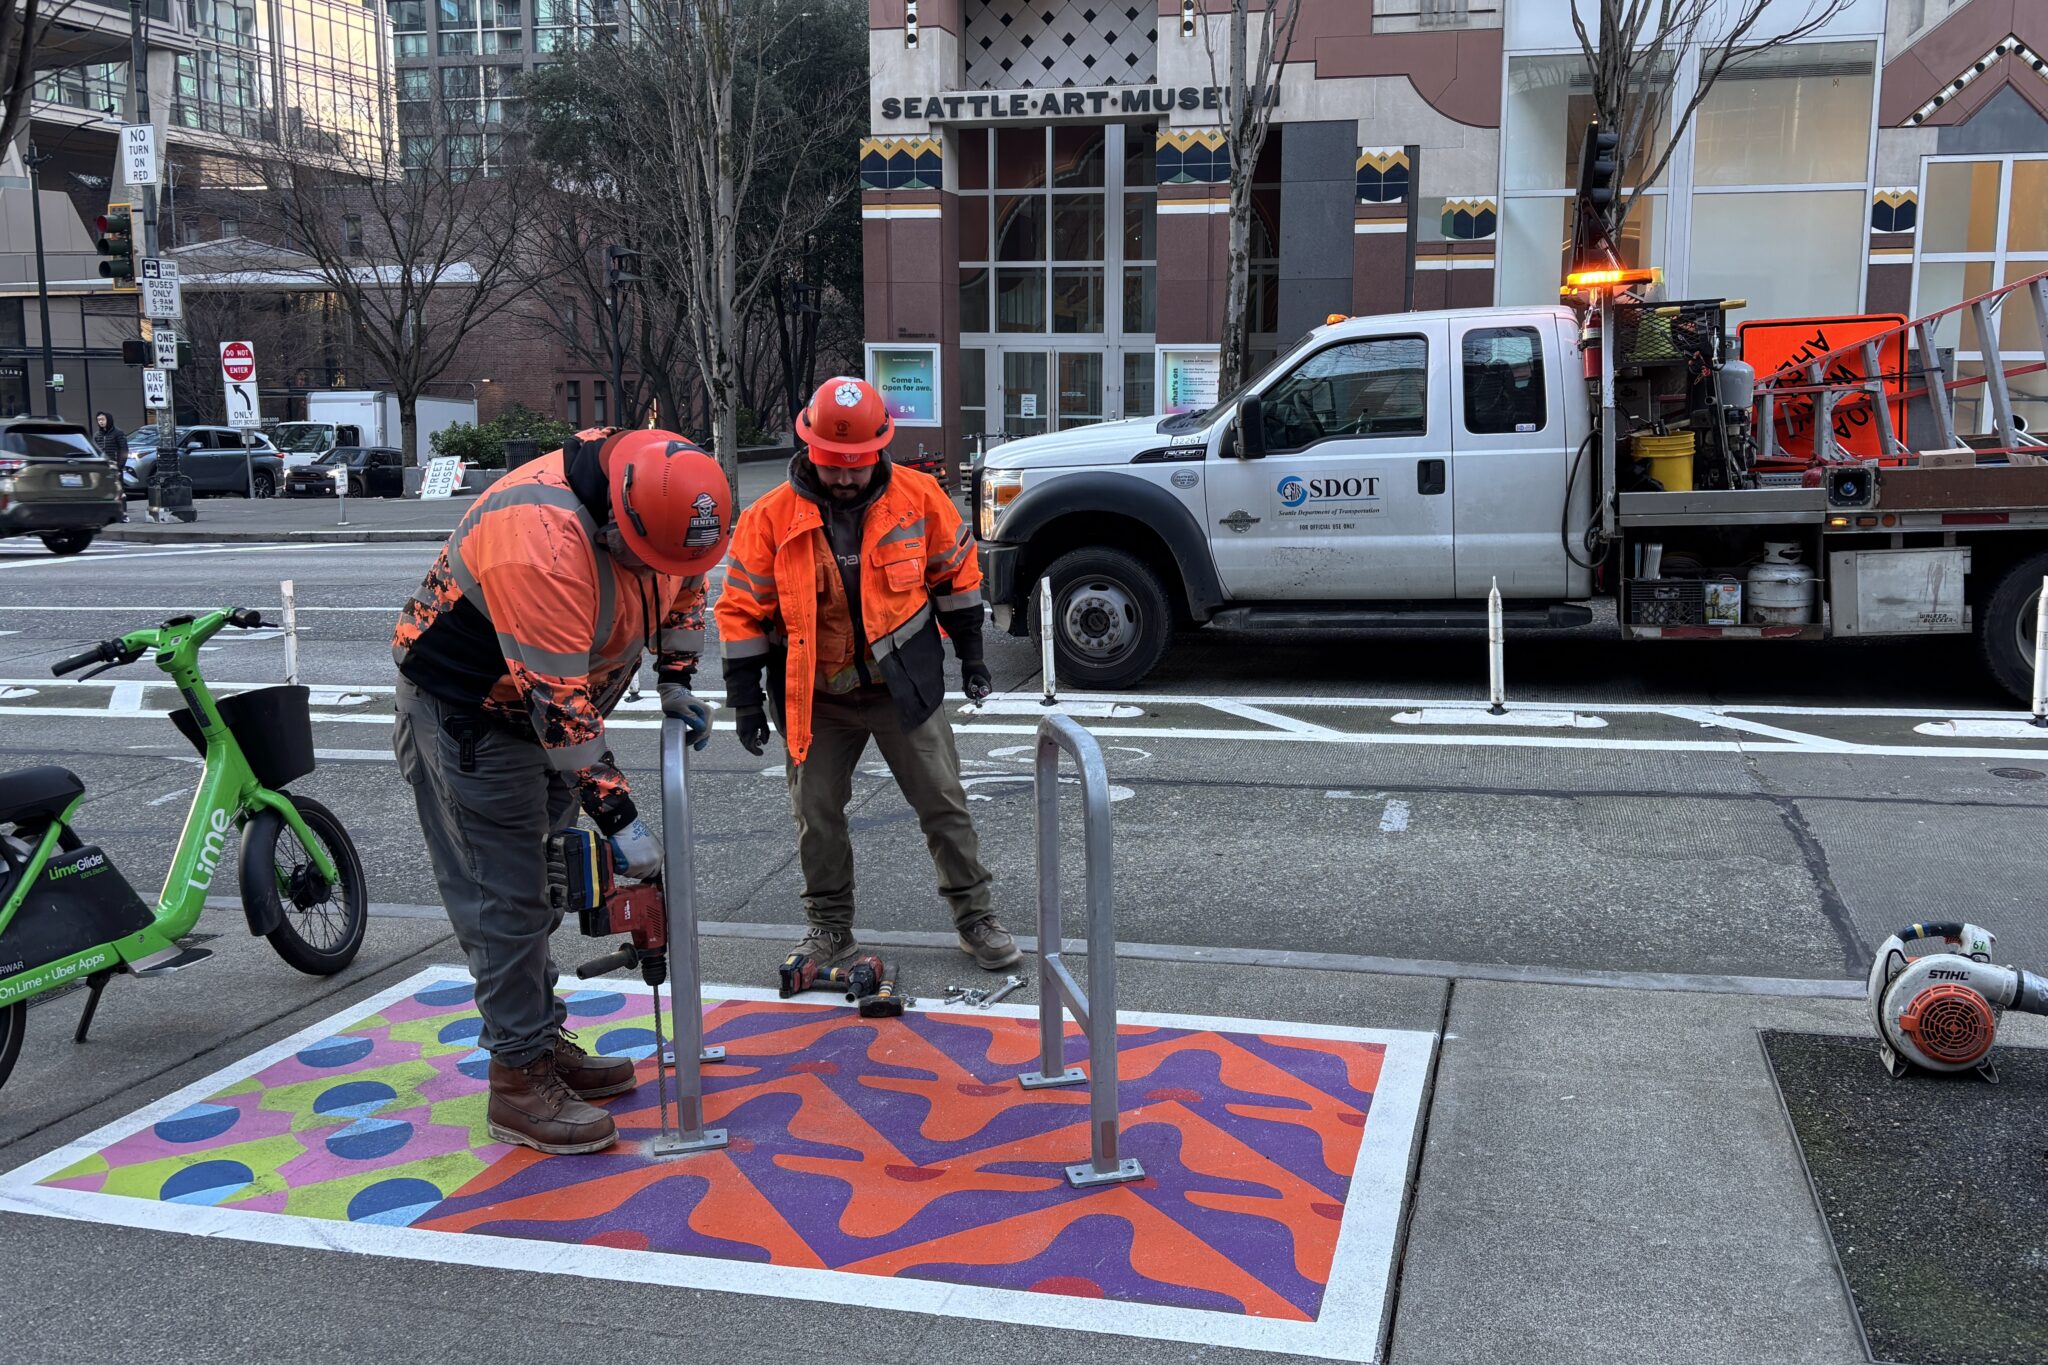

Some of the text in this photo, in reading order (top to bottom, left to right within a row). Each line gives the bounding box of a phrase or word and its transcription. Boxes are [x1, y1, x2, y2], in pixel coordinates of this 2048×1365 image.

[882, 85, 1281, 119] SEATTLE ART MUSEM
[130, 129, 146, 142] NO
[129, 145, 149, 155] TURN
[134, 158, 145, 168] ON
[133, 171, 149, 181] RED
[149, 280, 174, 289] BUSES
[152, 290, 171, 298] ONLY
[156, 333, 174, 343] ONE
[158, 344, 175, 353] WAY
[225, 349, 249, 357] DO NOT
[229, 366, 249, 374] ENTER
[1172, 368, 1179, 379] on
[146, 372, 164, 382] ONE
[146, 383, 164, 393] WAY
[234, 411, 254, 419] ONLY
[1174, 435, 1202, 445] 32267
[427, 461, 443, 495] STREET
[439, 459, 456, 495] CLOSED
[1309, 477, 1380, 498] SDOT
[1298, 508, 1331, 517] Department
[1331, 508, 1338, 516] of
[1339, 508, 1380, 516] Transportation
[1310, 523, 1331, 531] OFFICIAL
[187, 808, 230, 890] Lime
[48, 854, 104, 881] LimeGlider
[1972, 940, 1986, 950] 67
[0, 986, 16, 999] On
[16, 976, 42, 993] Lime
[51, 963, 76, 980] Uber
[79, 953, 105, 970] Apps
[1928, 969, 1970, 981] STIHL
